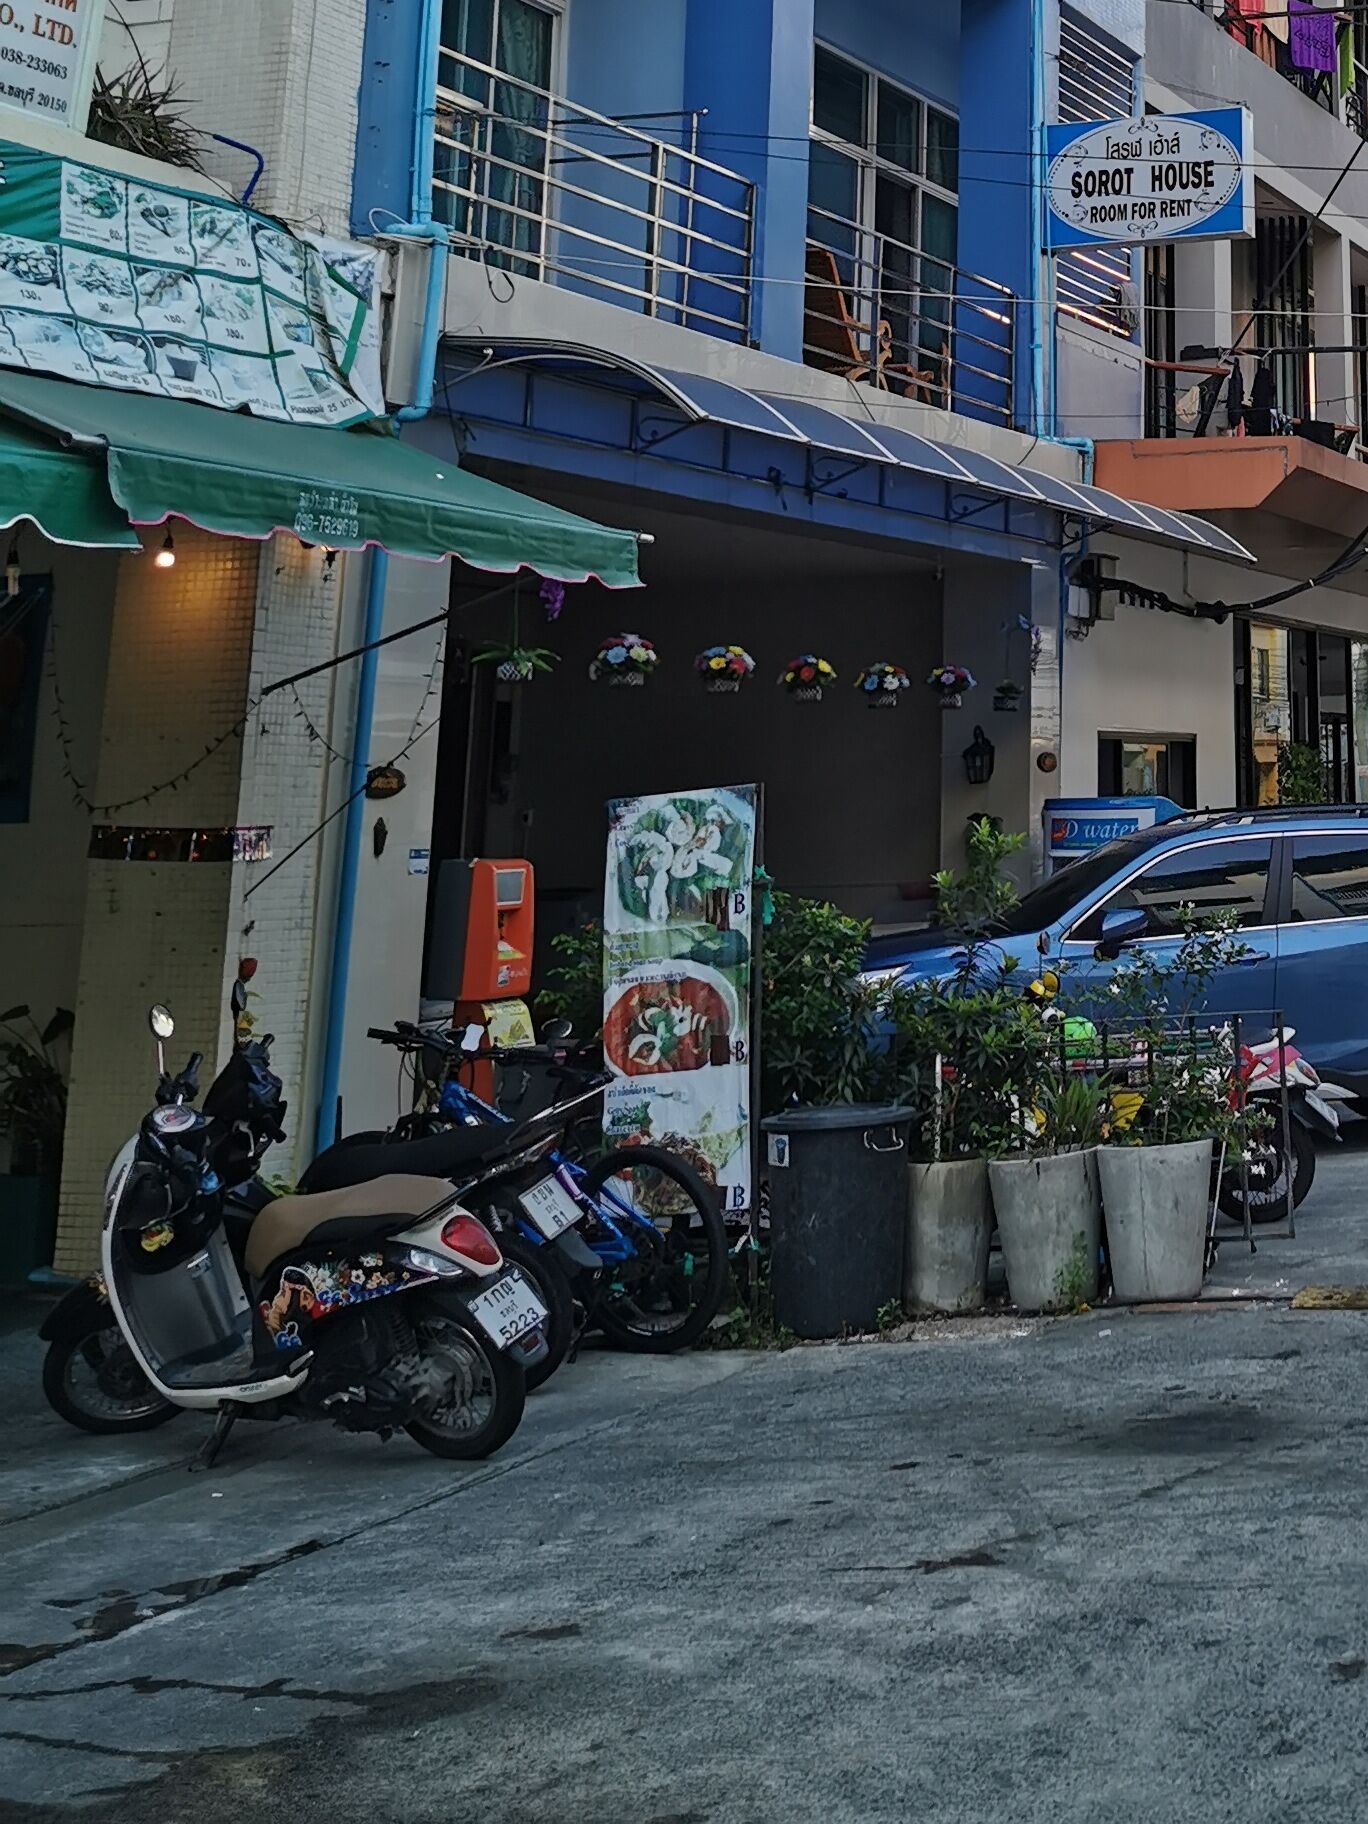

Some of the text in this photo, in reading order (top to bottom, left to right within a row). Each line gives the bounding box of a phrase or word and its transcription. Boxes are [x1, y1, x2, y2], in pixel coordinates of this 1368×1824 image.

[32, 13, 78, 49] LTD.
[1, 46, 68, 80] 038-233063
[37, 92, 68, 113] 20150
[1149, 132, 1180, 156] เฮ้าส์
[1071, 160, 1215, 198] SOROT HOUSE
[1090, 198, 1192, 224] ROOM FOR RENT
[1085, 822, 1140, 839] water
[499, 1307, 539, 1340] 5223
